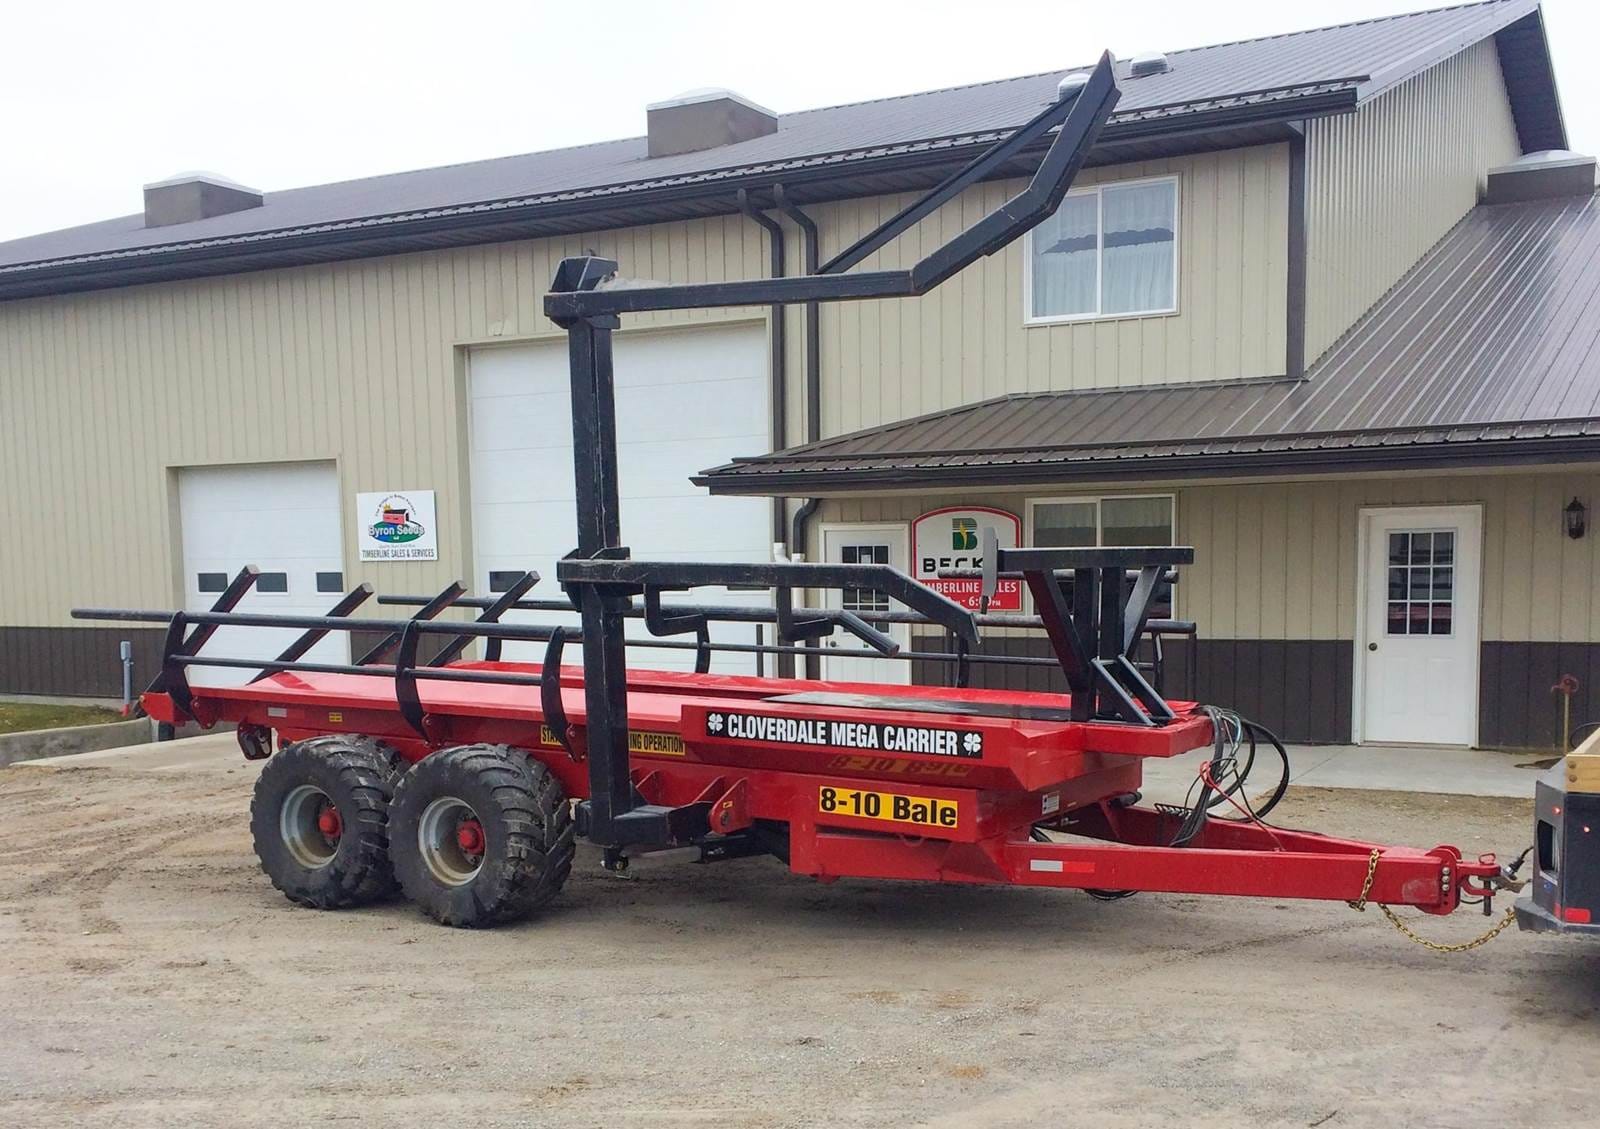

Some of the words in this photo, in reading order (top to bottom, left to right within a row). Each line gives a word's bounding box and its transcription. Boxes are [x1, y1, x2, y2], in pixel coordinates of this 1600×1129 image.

[368, 525, 395, 538] Byron
[396, 524, 425, 537] Seeds
[362, 549, 390, 559] TIMBERLINE
[391, 549, 406, 558] SALES
[406, 549, 410, 558] &
[411, 548, 434, 558] SERVICES
[923, 557, 984, 573] BECK
[629, 732, 642, 750] ING
[643, 733, 684, 753] OPERATION
[727, 714, 827, 745] CLOVERDALE
[831, 722, 879, 749] MEGA
[883, 726, 958, 756] CARRIER
[821, 788, 881, 817] 8-10
[893, 795, 957, 827] Bale
